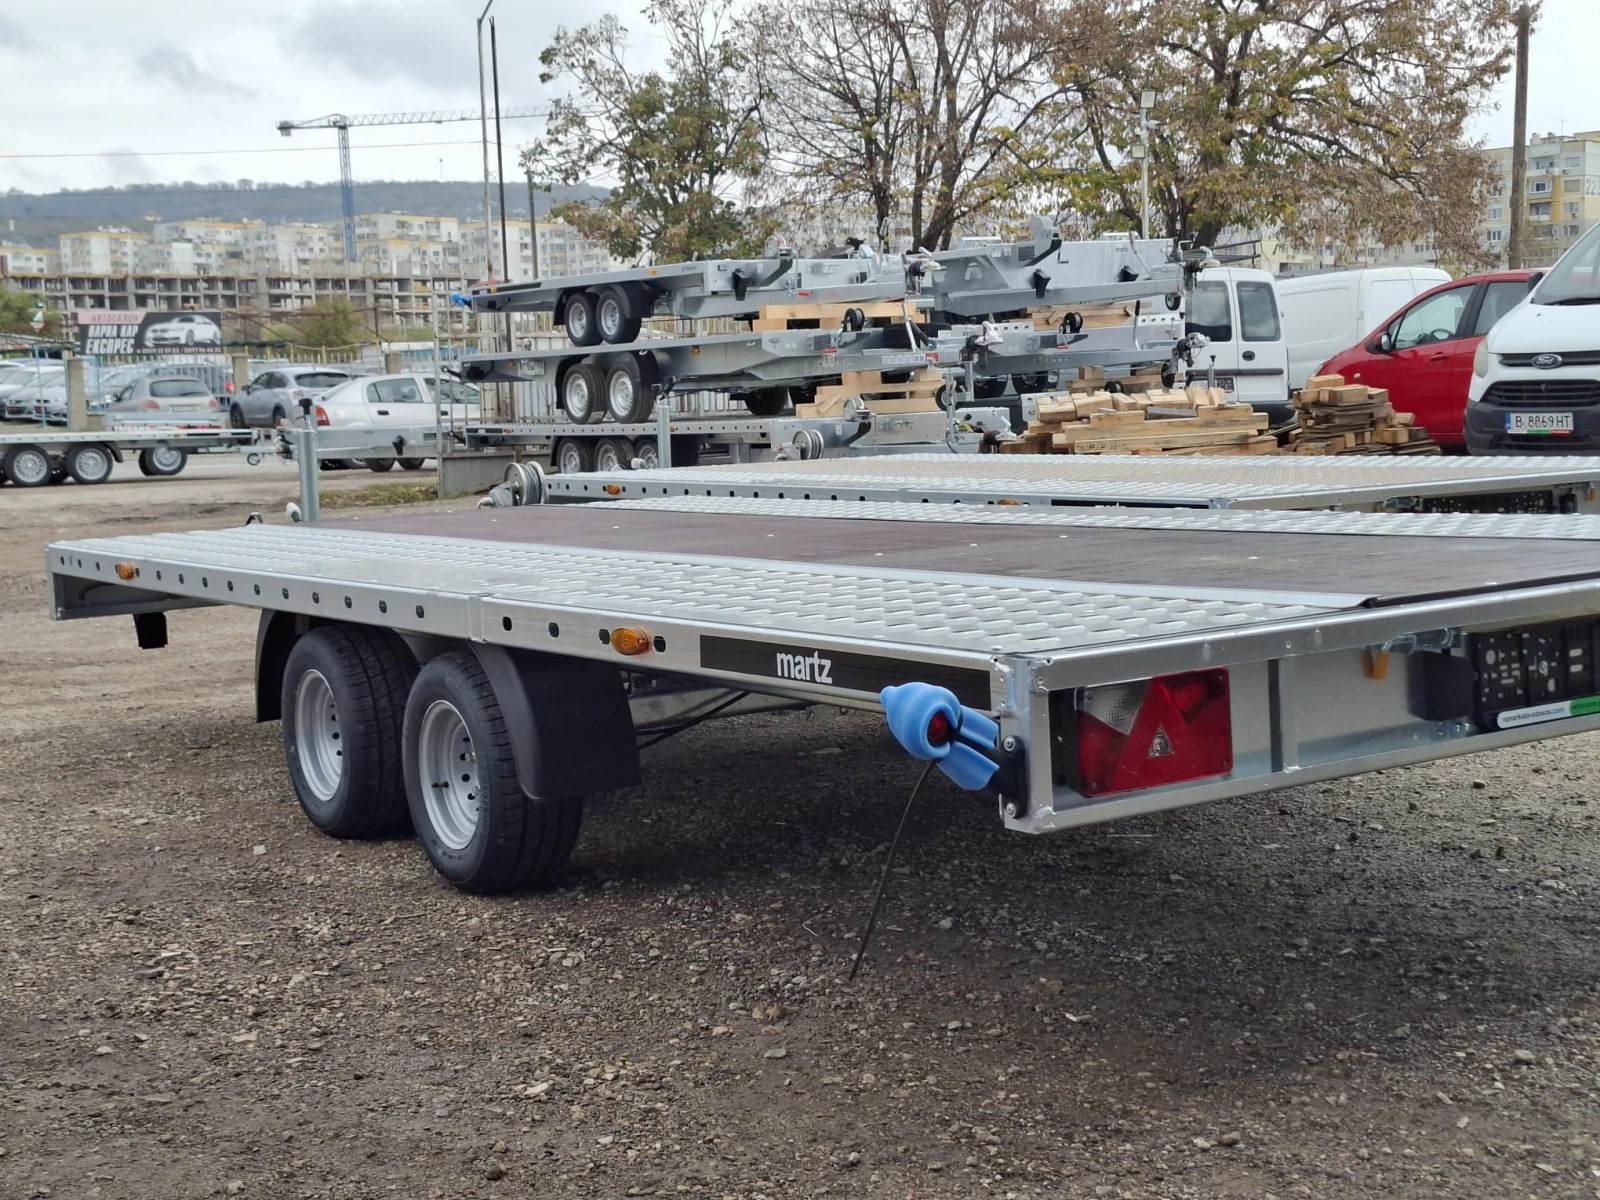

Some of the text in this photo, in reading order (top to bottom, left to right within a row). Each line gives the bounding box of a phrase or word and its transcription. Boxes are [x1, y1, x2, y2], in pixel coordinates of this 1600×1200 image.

[91, 314, 139, 323] АВТОСАЛОН
[120, 324, 139, 338] КАР
[85, 338, 135, 354] ЕКСПРЕС
[1528, 415, 1555, 428] 8869
[1556, 415, 1571, 428] HT
[776, 650, 833, 684] martz
